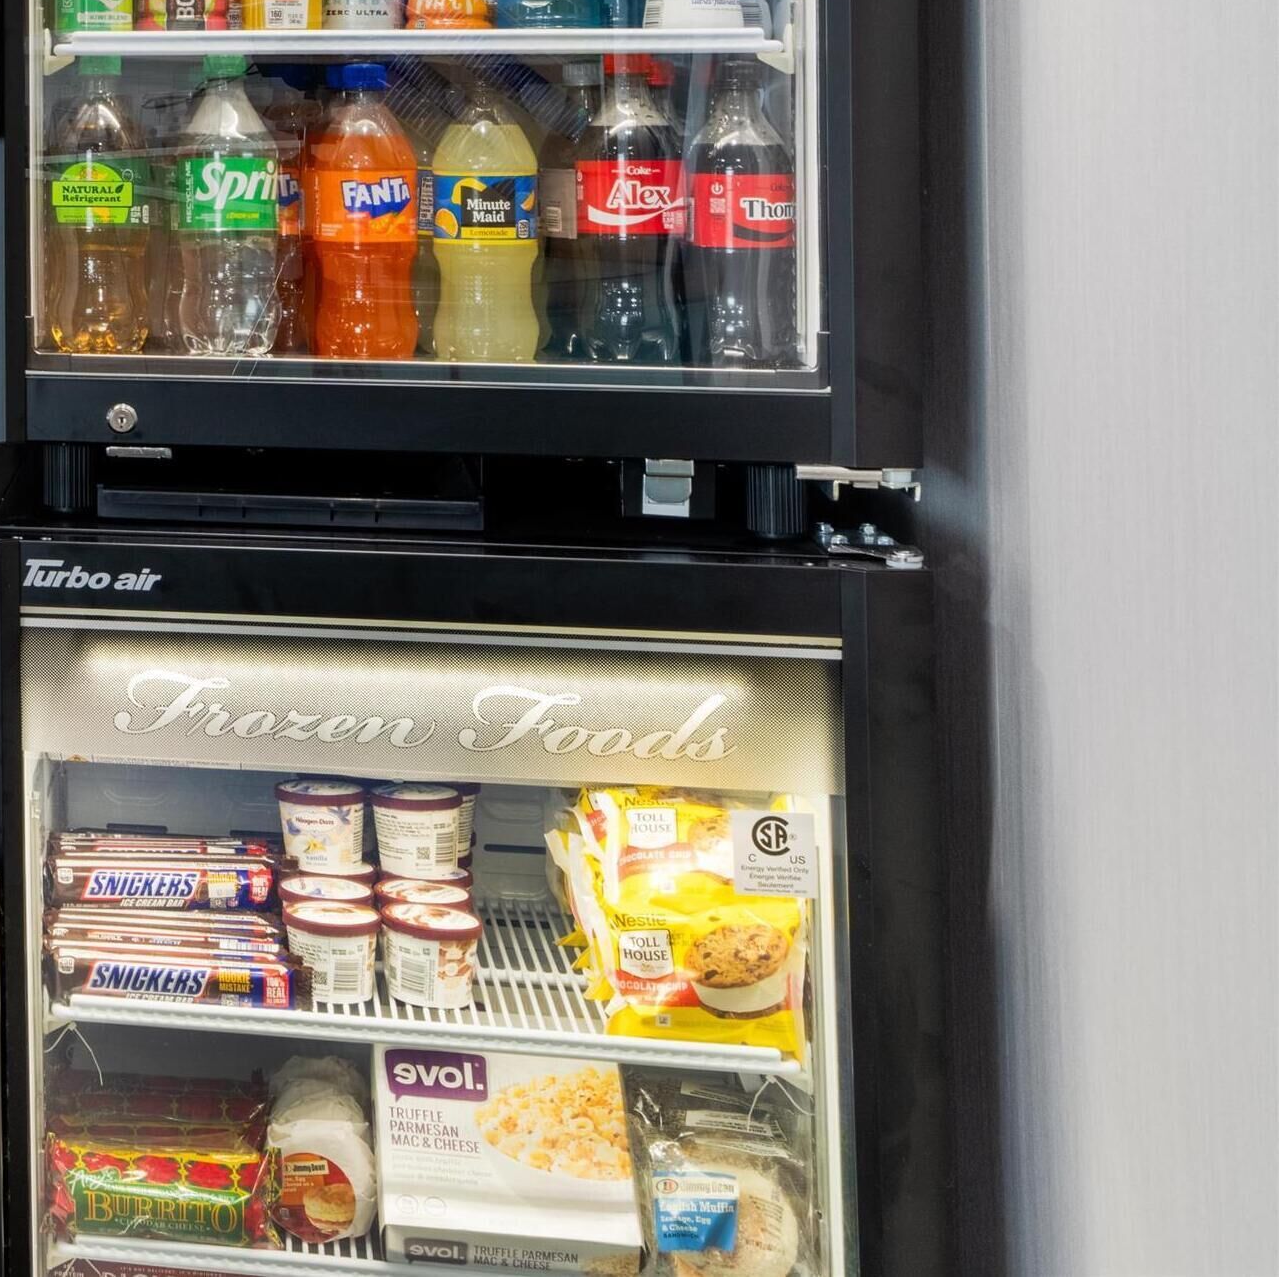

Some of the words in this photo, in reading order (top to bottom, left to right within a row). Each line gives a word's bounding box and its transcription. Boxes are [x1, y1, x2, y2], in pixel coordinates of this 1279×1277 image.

[626, 166, 652, 176] Coke
[62, 185, 114, 194] NATURAL
[342, 178, 411, 207] FANTA
[607, 180, 672, 209] Alex
[62, 194, 122, 203] Refrigerant
[113, 668, 436, 749] Frozen
[458, 684, 737, 761] Foods
[120, 898, 136, 907] ICE
[137, 898, 168, 907] CREAM
[169, 899, 185, 907] BAR
[631, 937, 660, 948] TOLL
[623, 949, 669, 961] HOUSE
[388, 1106, 443, 1122] TRUFFLE
[389, 1121, 459, 1138] PARMESAN
[391, 1134, 419, 1148] MAC
[421, 1136, 432, 1149] &
[434, 1137, 481, 1153] CHEESE
[84, 1190, 238, 1235] BURRITO
